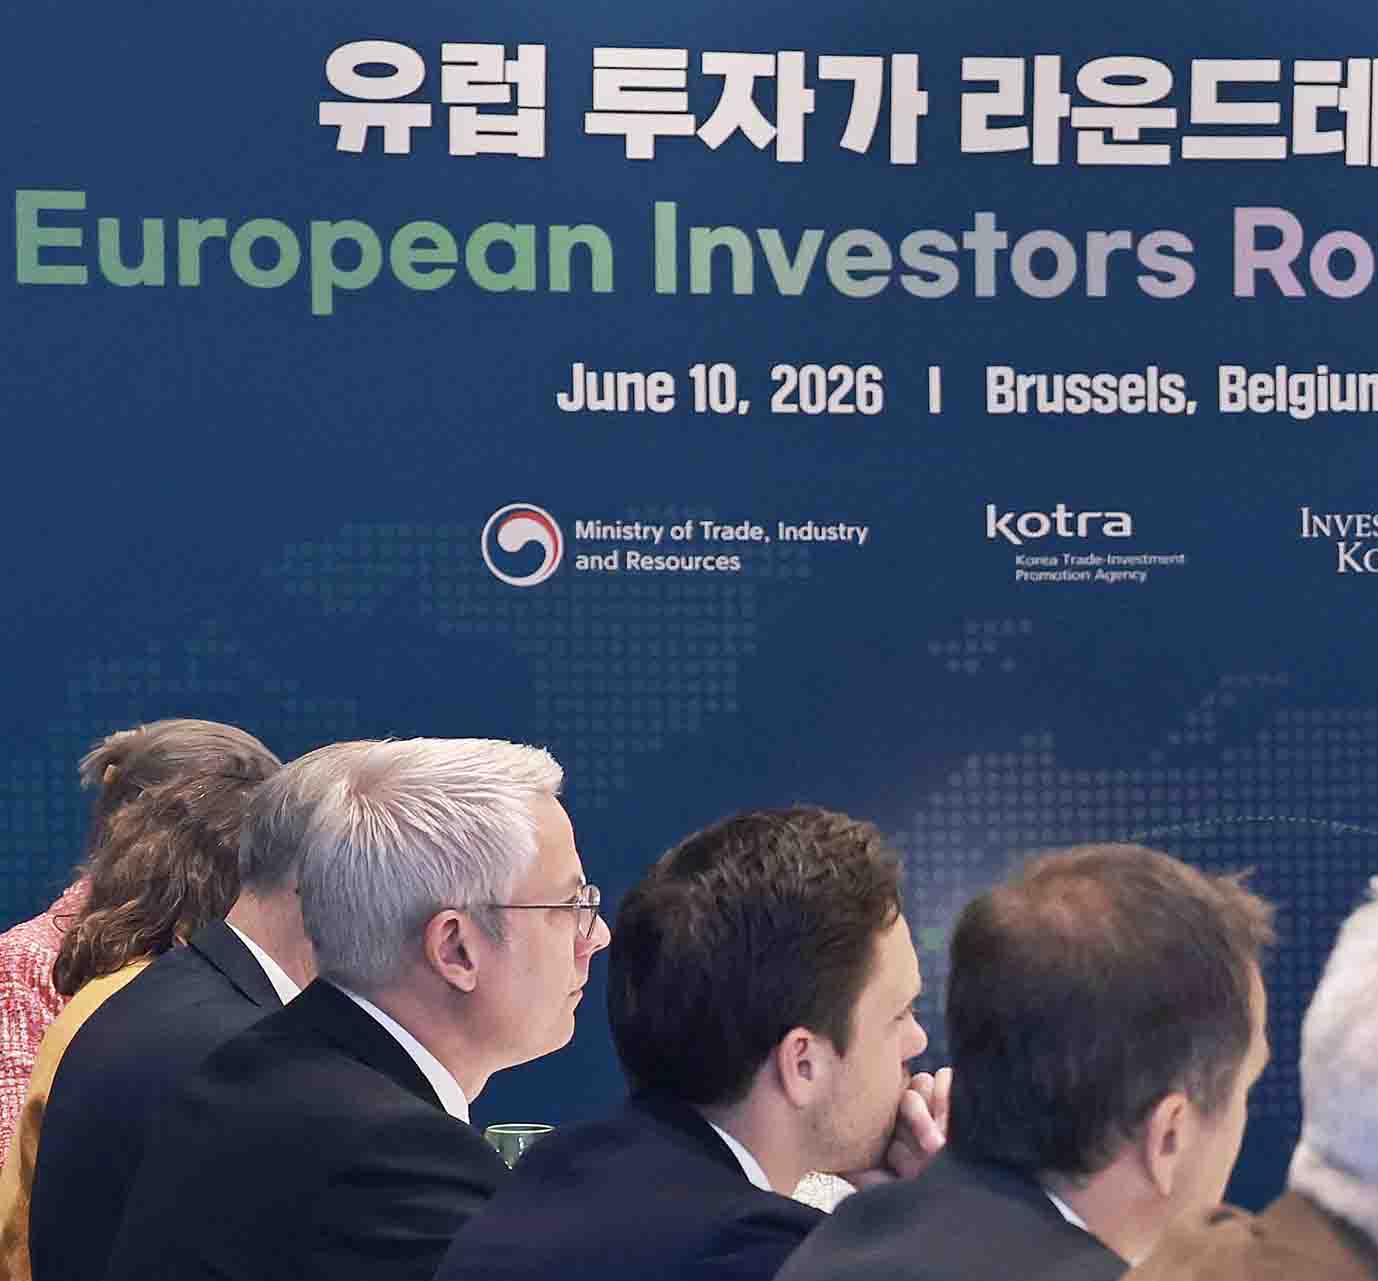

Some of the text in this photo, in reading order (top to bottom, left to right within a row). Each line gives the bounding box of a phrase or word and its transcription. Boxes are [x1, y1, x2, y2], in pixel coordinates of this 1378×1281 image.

[318, 40, 546, 158] 유럽
[584, 47, 929, 165] 투자가
[12, 189, 614, 316] European
[654, 200, 1196, 299] Investors
[556, 362, 675, 413] June
[689, 362, 750, 415] 10,
[770, 364, 884, 415] 2026
[986, 365, 1197, 416] Brussels,
[575, 519, 869, 545] Ministry of Trade, Industry
[986, 503, 1132, 545] kotra
[575, 549, 742, 571] and Resources
[1015, 552, 1185, 567] Korea Trade-Investment
[1015, 569, 1147, 583] Promotion Agency
